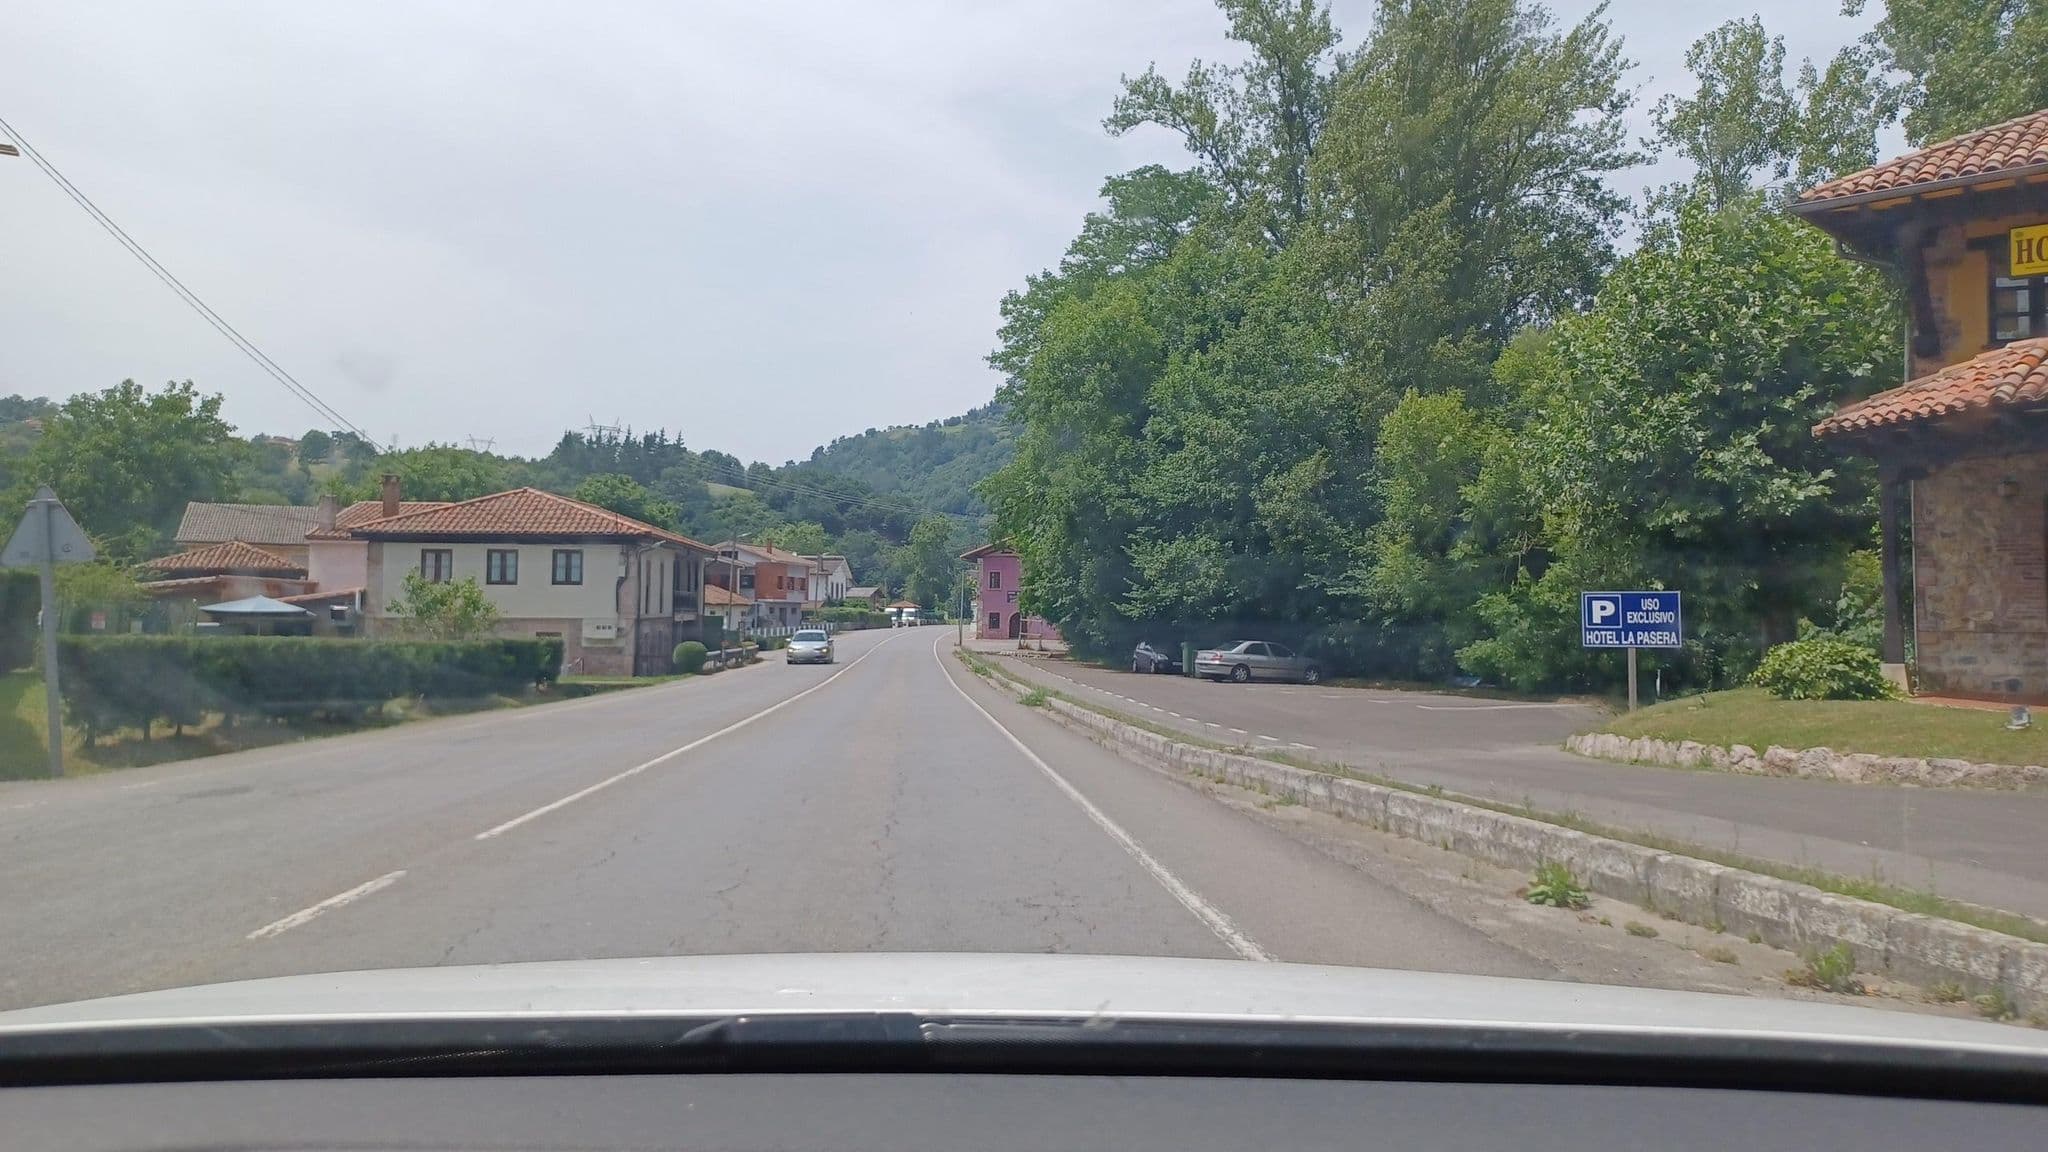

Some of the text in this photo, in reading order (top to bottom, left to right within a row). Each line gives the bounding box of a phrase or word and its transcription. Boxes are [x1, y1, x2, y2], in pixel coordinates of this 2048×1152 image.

[1641, 598, 1660, 610] USO
[1592, 600, 1616, 624] P
[1627, 611, 1675, 623] EXCLUSIVO
[1586, 631, 1678, 644] HOTEL LA PASERA
